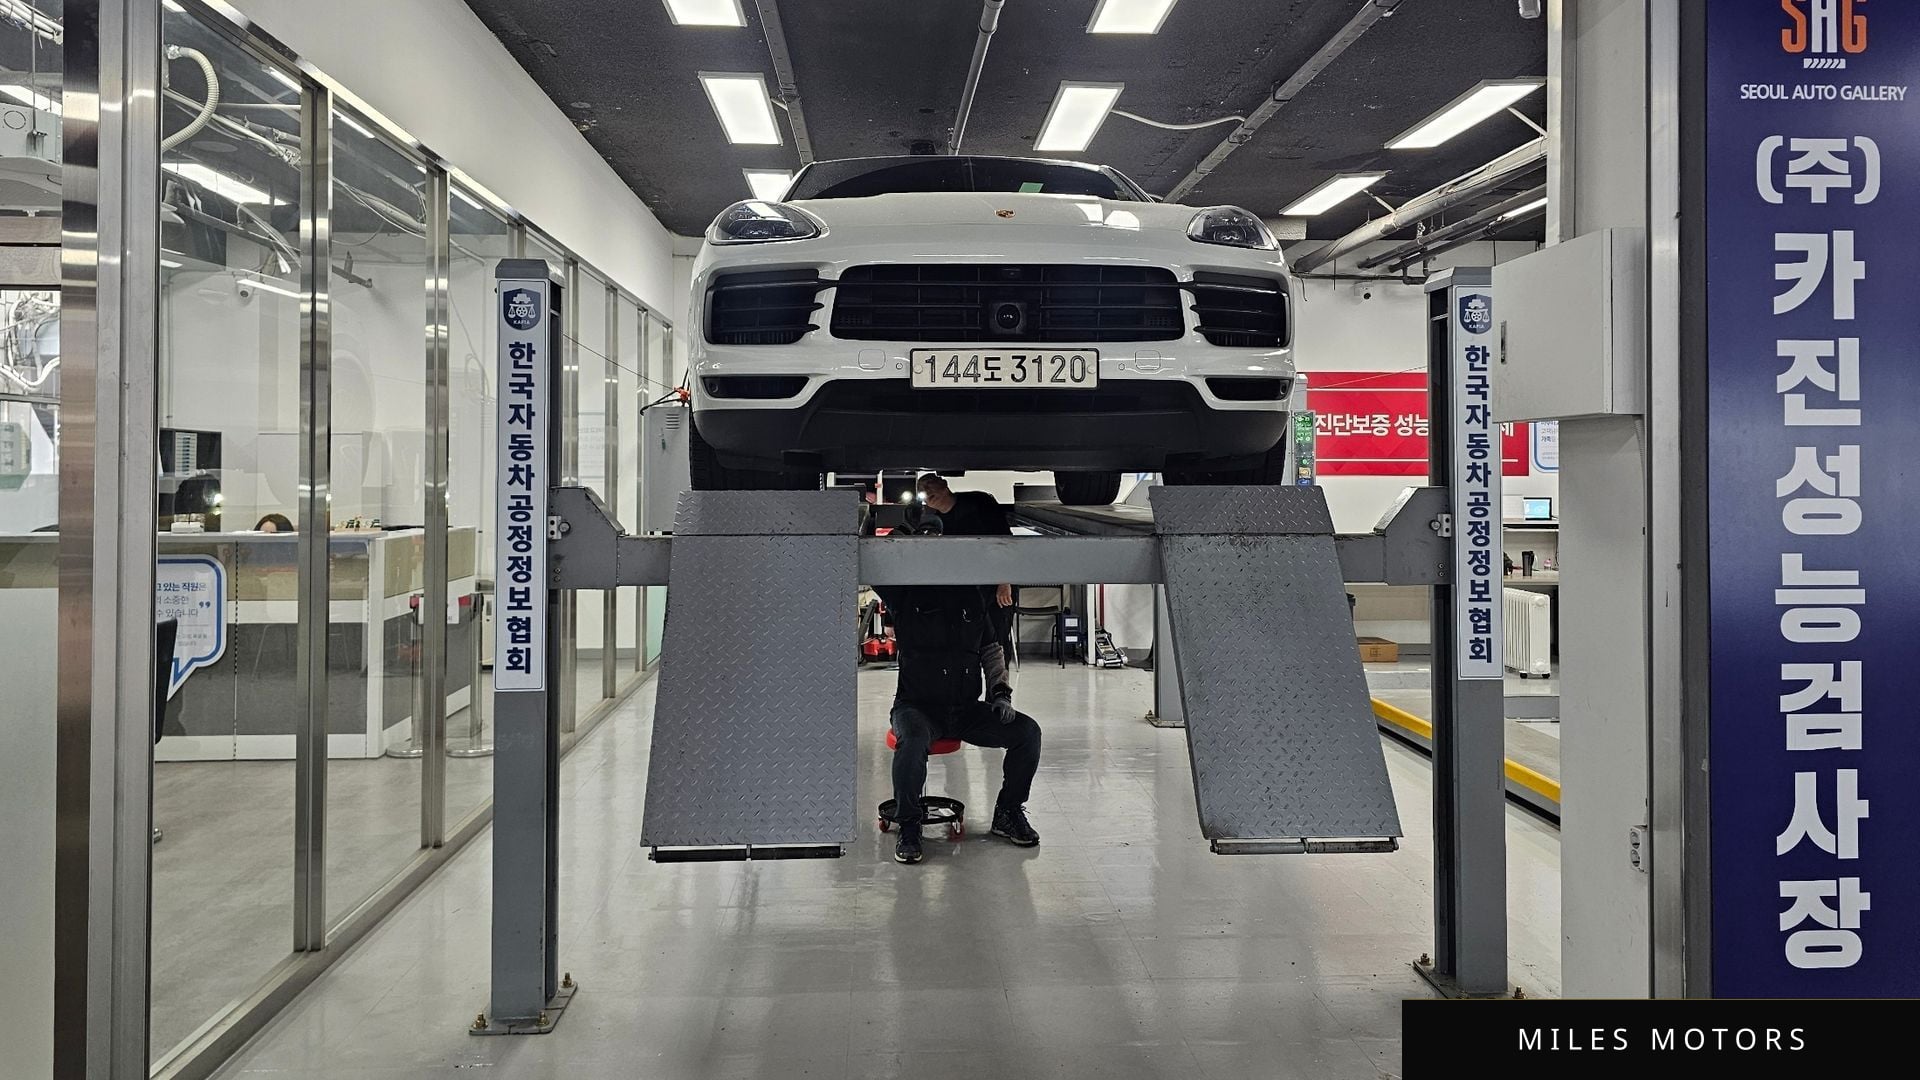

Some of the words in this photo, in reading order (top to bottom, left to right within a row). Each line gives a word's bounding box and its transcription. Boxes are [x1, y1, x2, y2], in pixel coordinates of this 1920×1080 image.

[1740, 84, 1788, 100] SEOUL
[1791, 84, 1837, 100] AUTO
[1840, 85, 1908, 101] GALLERY
[505, 341, 536, 675] 한국자동차공정정보협회
[1464, 344, 1493, 664] 한국자동차공정정보협회
